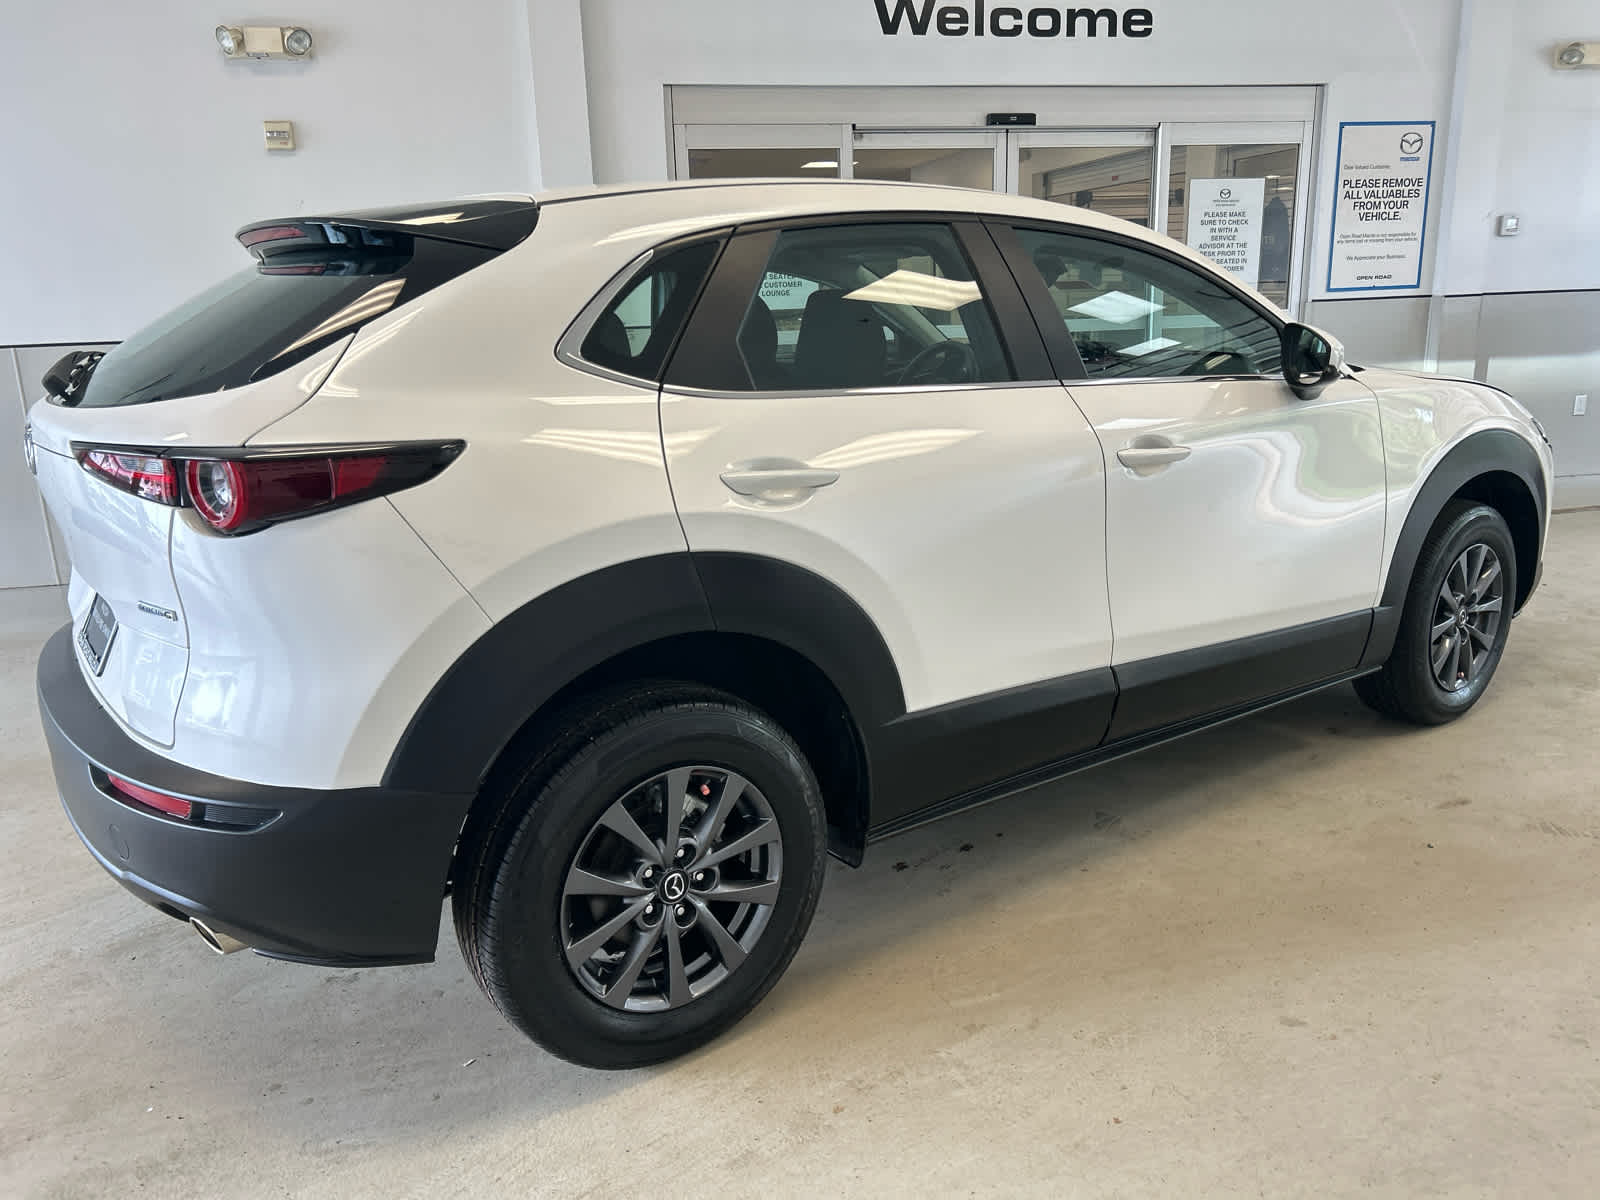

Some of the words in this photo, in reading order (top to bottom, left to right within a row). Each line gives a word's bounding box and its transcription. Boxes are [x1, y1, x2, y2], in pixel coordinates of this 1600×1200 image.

[874, 0, 1153, 38] Welcome
[1342, 178, 1380, 188] PLEASE
[1382, 178, 1424, 188] REMOVE
[1344, 190, 1362, 200] ALL
[1364, 188, 1420, 199] VALUABLES
[1353, 201, 1381, 210] FROM
[1382, 200, 1408, 210] YOUR
[1358, 211, 1402, 221] VEHICLE.
